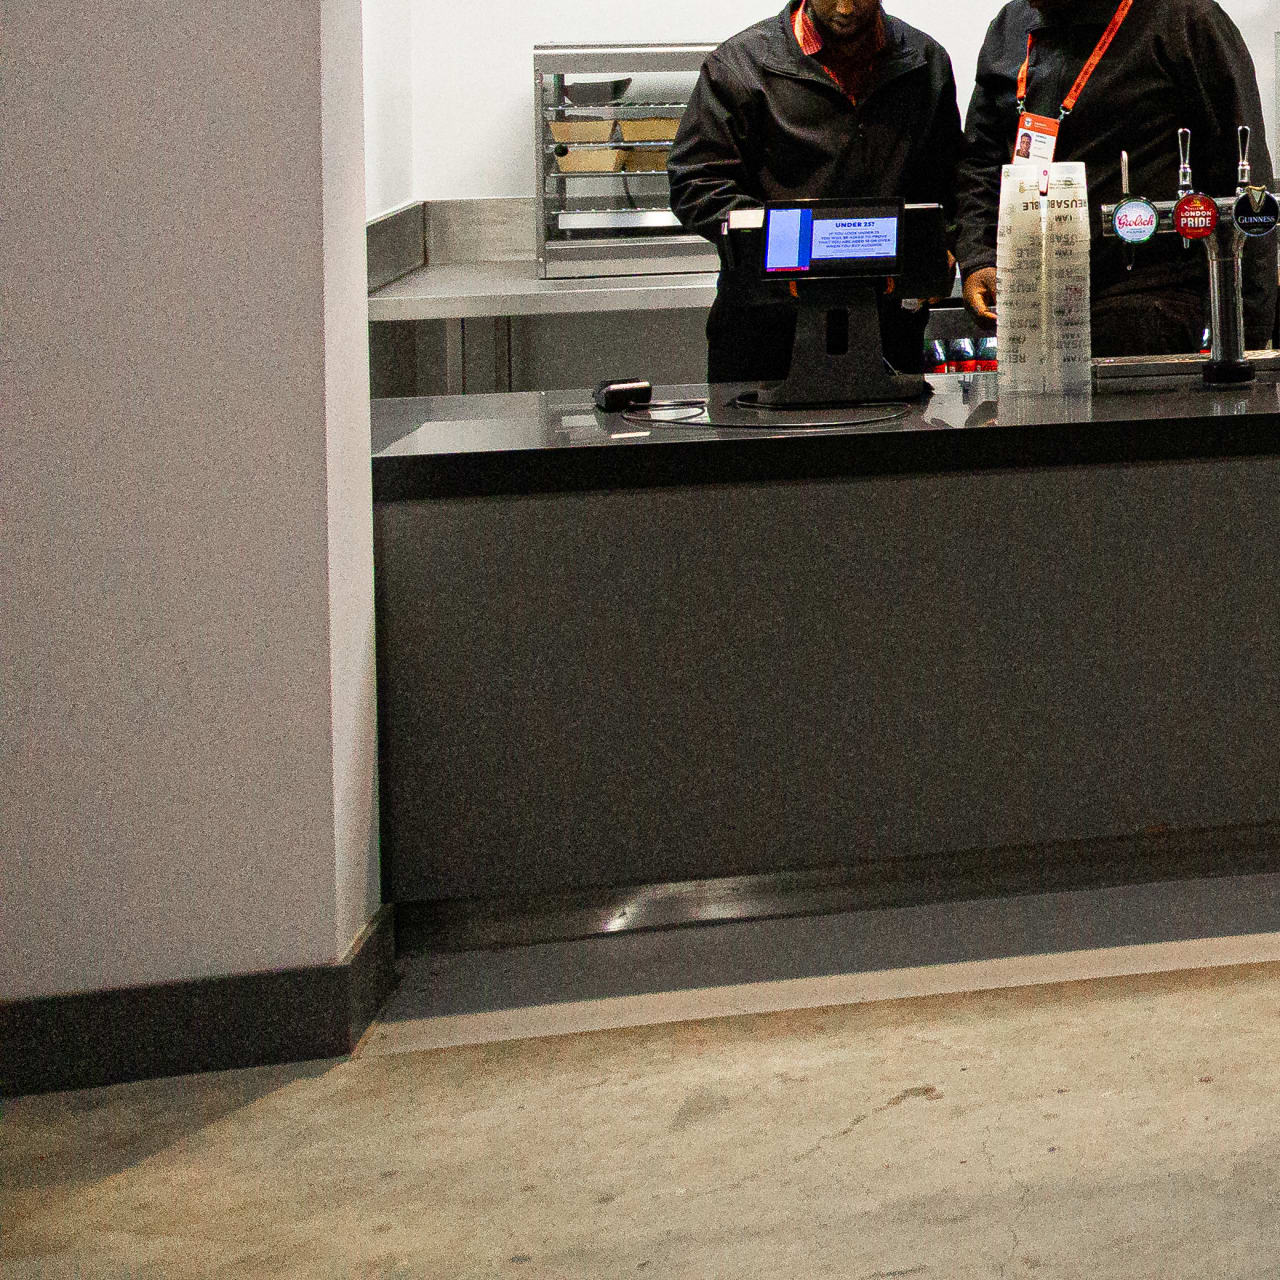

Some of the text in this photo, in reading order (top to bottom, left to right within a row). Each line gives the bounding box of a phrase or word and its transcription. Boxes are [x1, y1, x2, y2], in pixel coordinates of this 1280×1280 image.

[1117, 213, 1155, 229] Grolsch
[1181, 217, 1211, 227] PRIDE
[1238, 215, 1275, 224] GUINNESS
